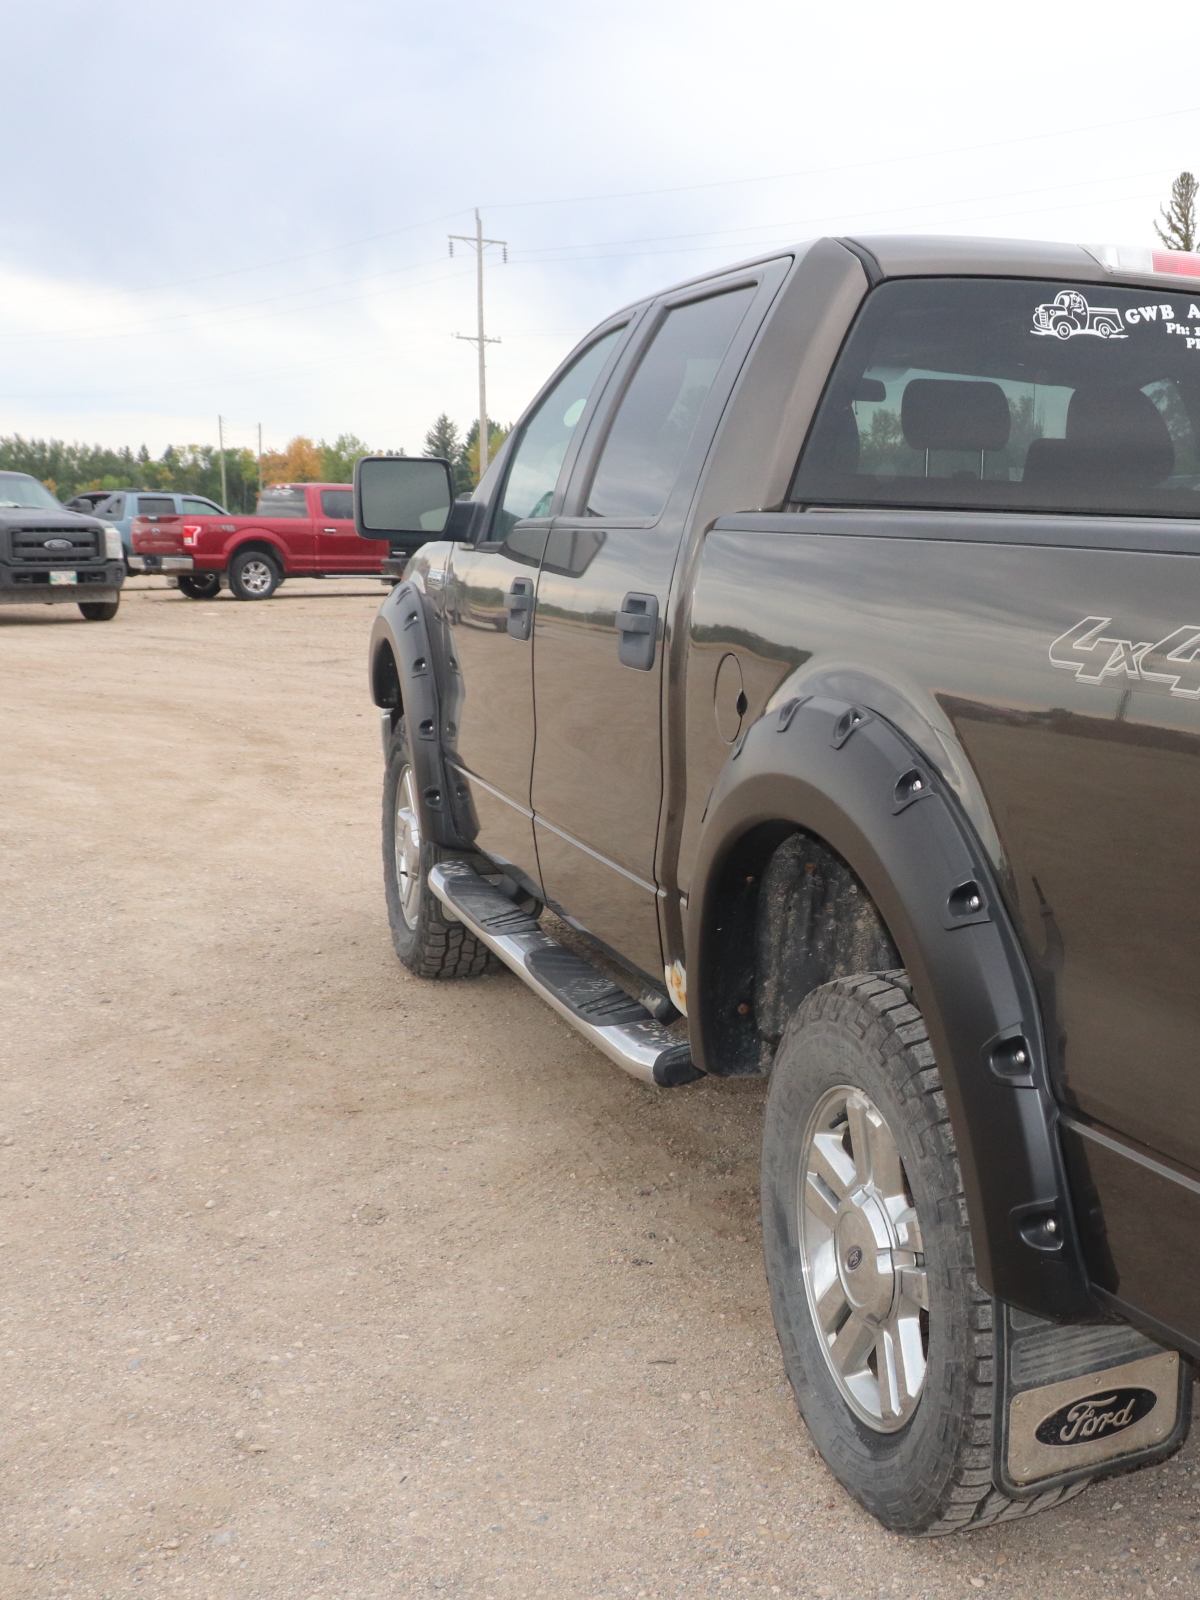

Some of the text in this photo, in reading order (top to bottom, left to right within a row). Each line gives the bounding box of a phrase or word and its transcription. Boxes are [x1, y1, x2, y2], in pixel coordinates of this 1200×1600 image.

[1125, 304, 1175, 323] GWB
[1165, 322, 1190, 335] Ph:
[1059, 1395, 1136, 1442] Ford
